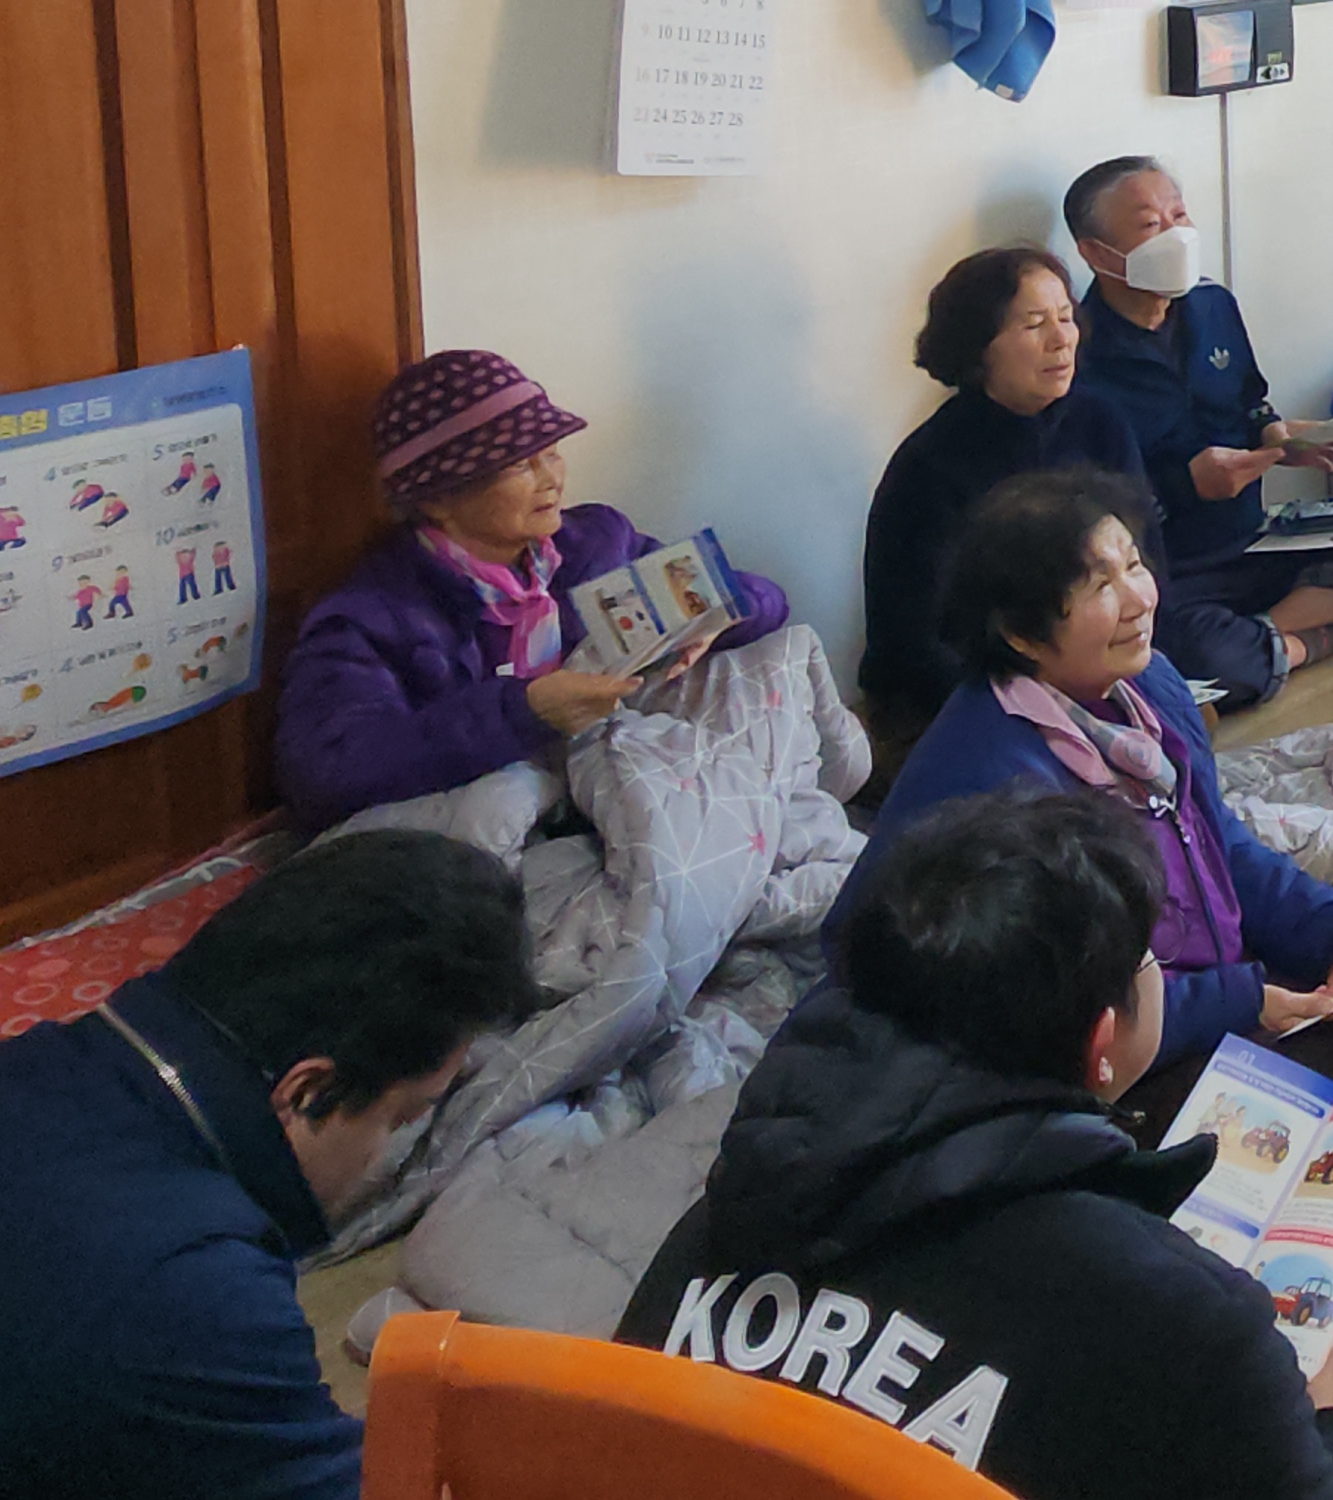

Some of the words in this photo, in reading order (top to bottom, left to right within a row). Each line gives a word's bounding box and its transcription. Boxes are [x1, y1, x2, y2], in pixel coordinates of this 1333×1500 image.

[658, 24, 672, 39] 10
[678, 26, 690, 41] 11
[696, 28, 711, 43] 12
[716, 30, 729, 45] 13
[734, 32, 747, 46] 14
[752, 33, 765, 49] 15
[656, 68, 670, 83] 17
[675, 70, 688, 85] 18
[694, 71, 708, 86] 19
[711, 73, 726, 87] 20
[730, 74, 743, 89] 21
[749, 75, 763, 90] 22
[653, 108, 667, 123] 24
[672, 109, 687, 124] 25
[691, 110, 705, 125] 26
[709, 111, 724, 126] 27
[729, 112, 743, 126] 28
[152, 444, 164, 461] 5
[156, 527, 175, 546] 10
[52, 555, 64, 572] 9
[663, 1271, 1009, 1472] KOREA
